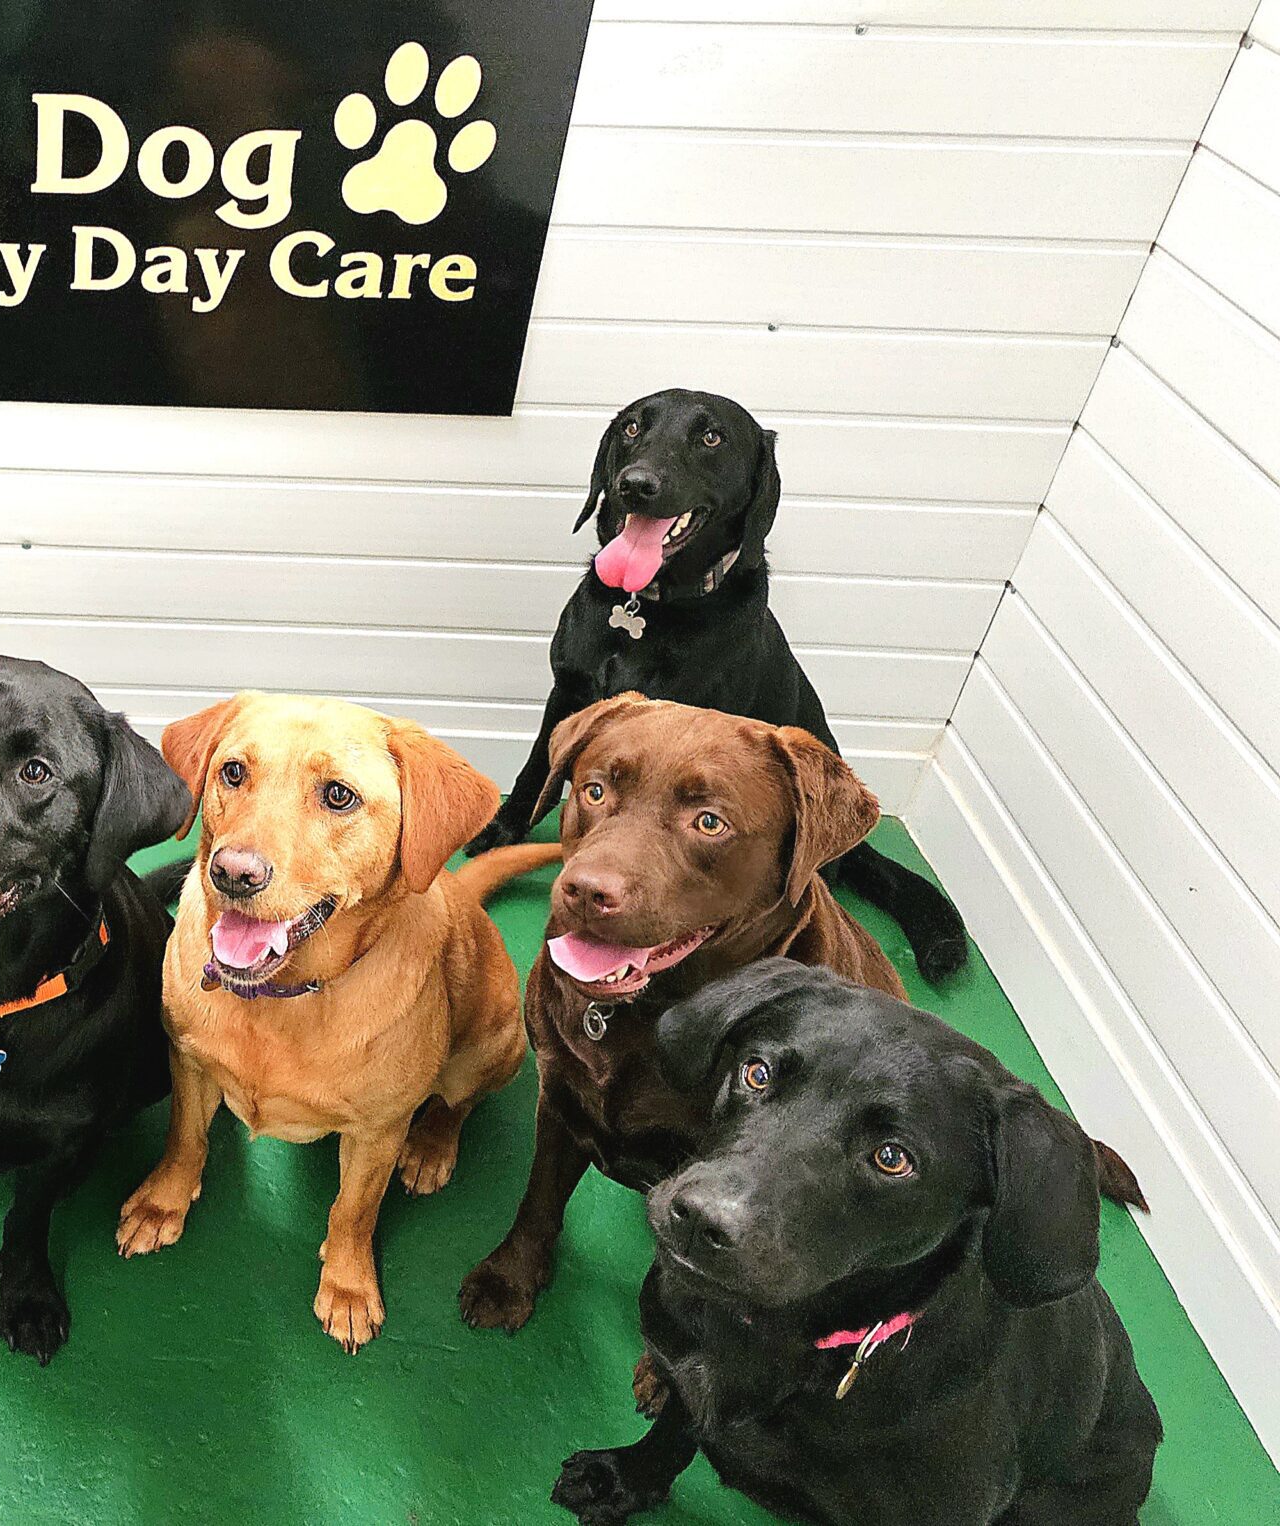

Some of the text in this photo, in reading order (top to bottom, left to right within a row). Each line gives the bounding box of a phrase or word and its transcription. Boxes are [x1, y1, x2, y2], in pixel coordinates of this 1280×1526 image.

[30, 93, 302, 230] Dog
[69, 225, 246, 313] Day
[269, 230, 477, 302] Care
